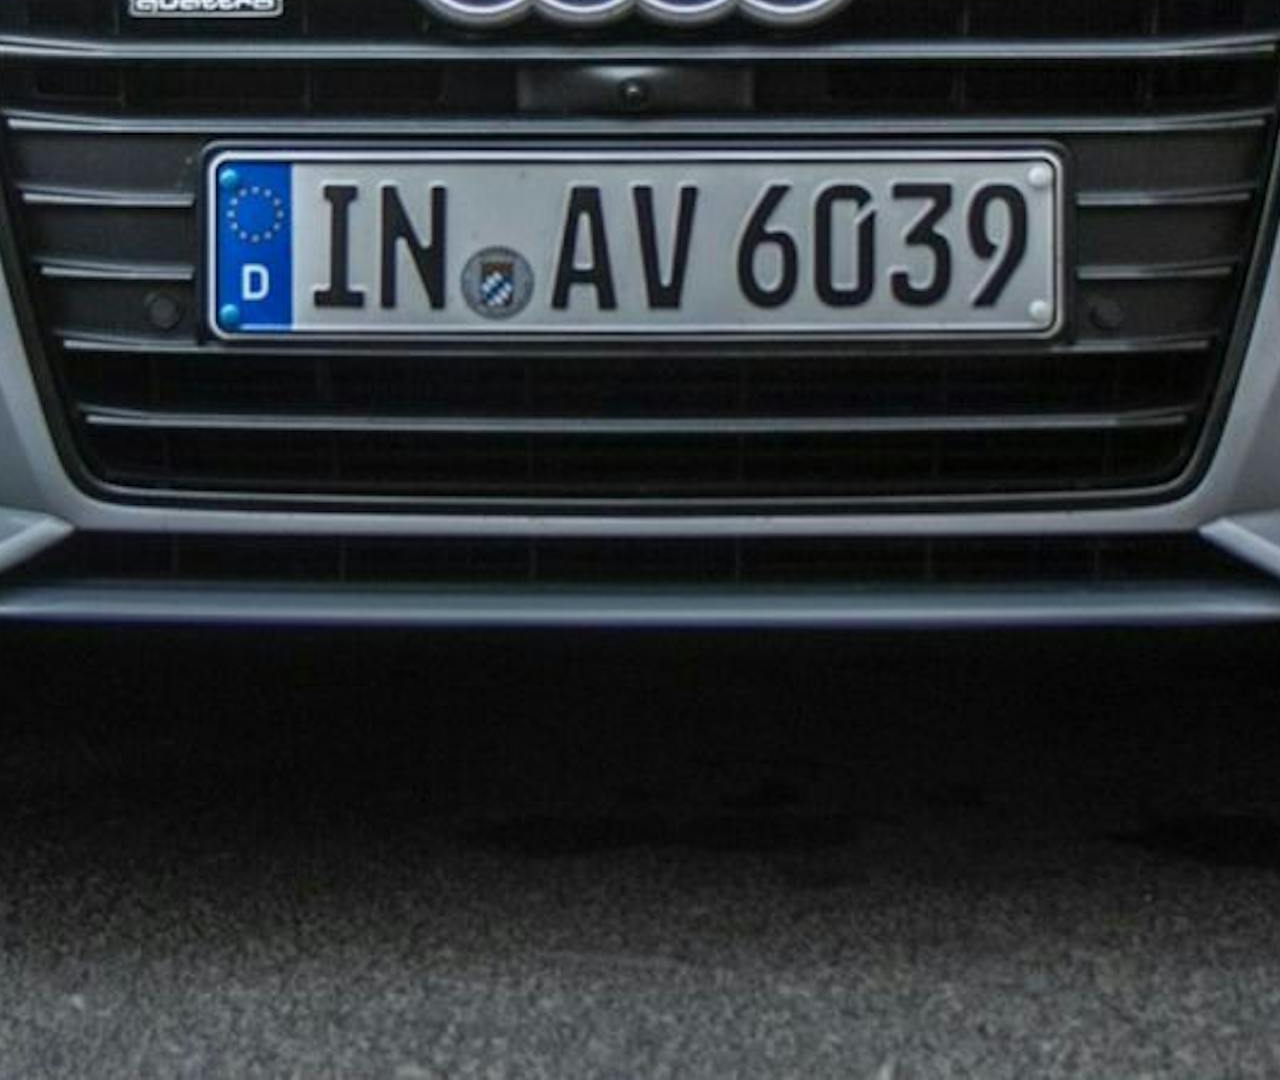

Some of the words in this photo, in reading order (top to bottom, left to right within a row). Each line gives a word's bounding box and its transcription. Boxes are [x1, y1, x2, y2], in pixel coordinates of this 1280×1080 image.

[241, 264, 270, 301] D
[312, 184, 448, 310] IN
[551, 185, 699, 310] AV
[736, 183, 1029, 309] 6039
